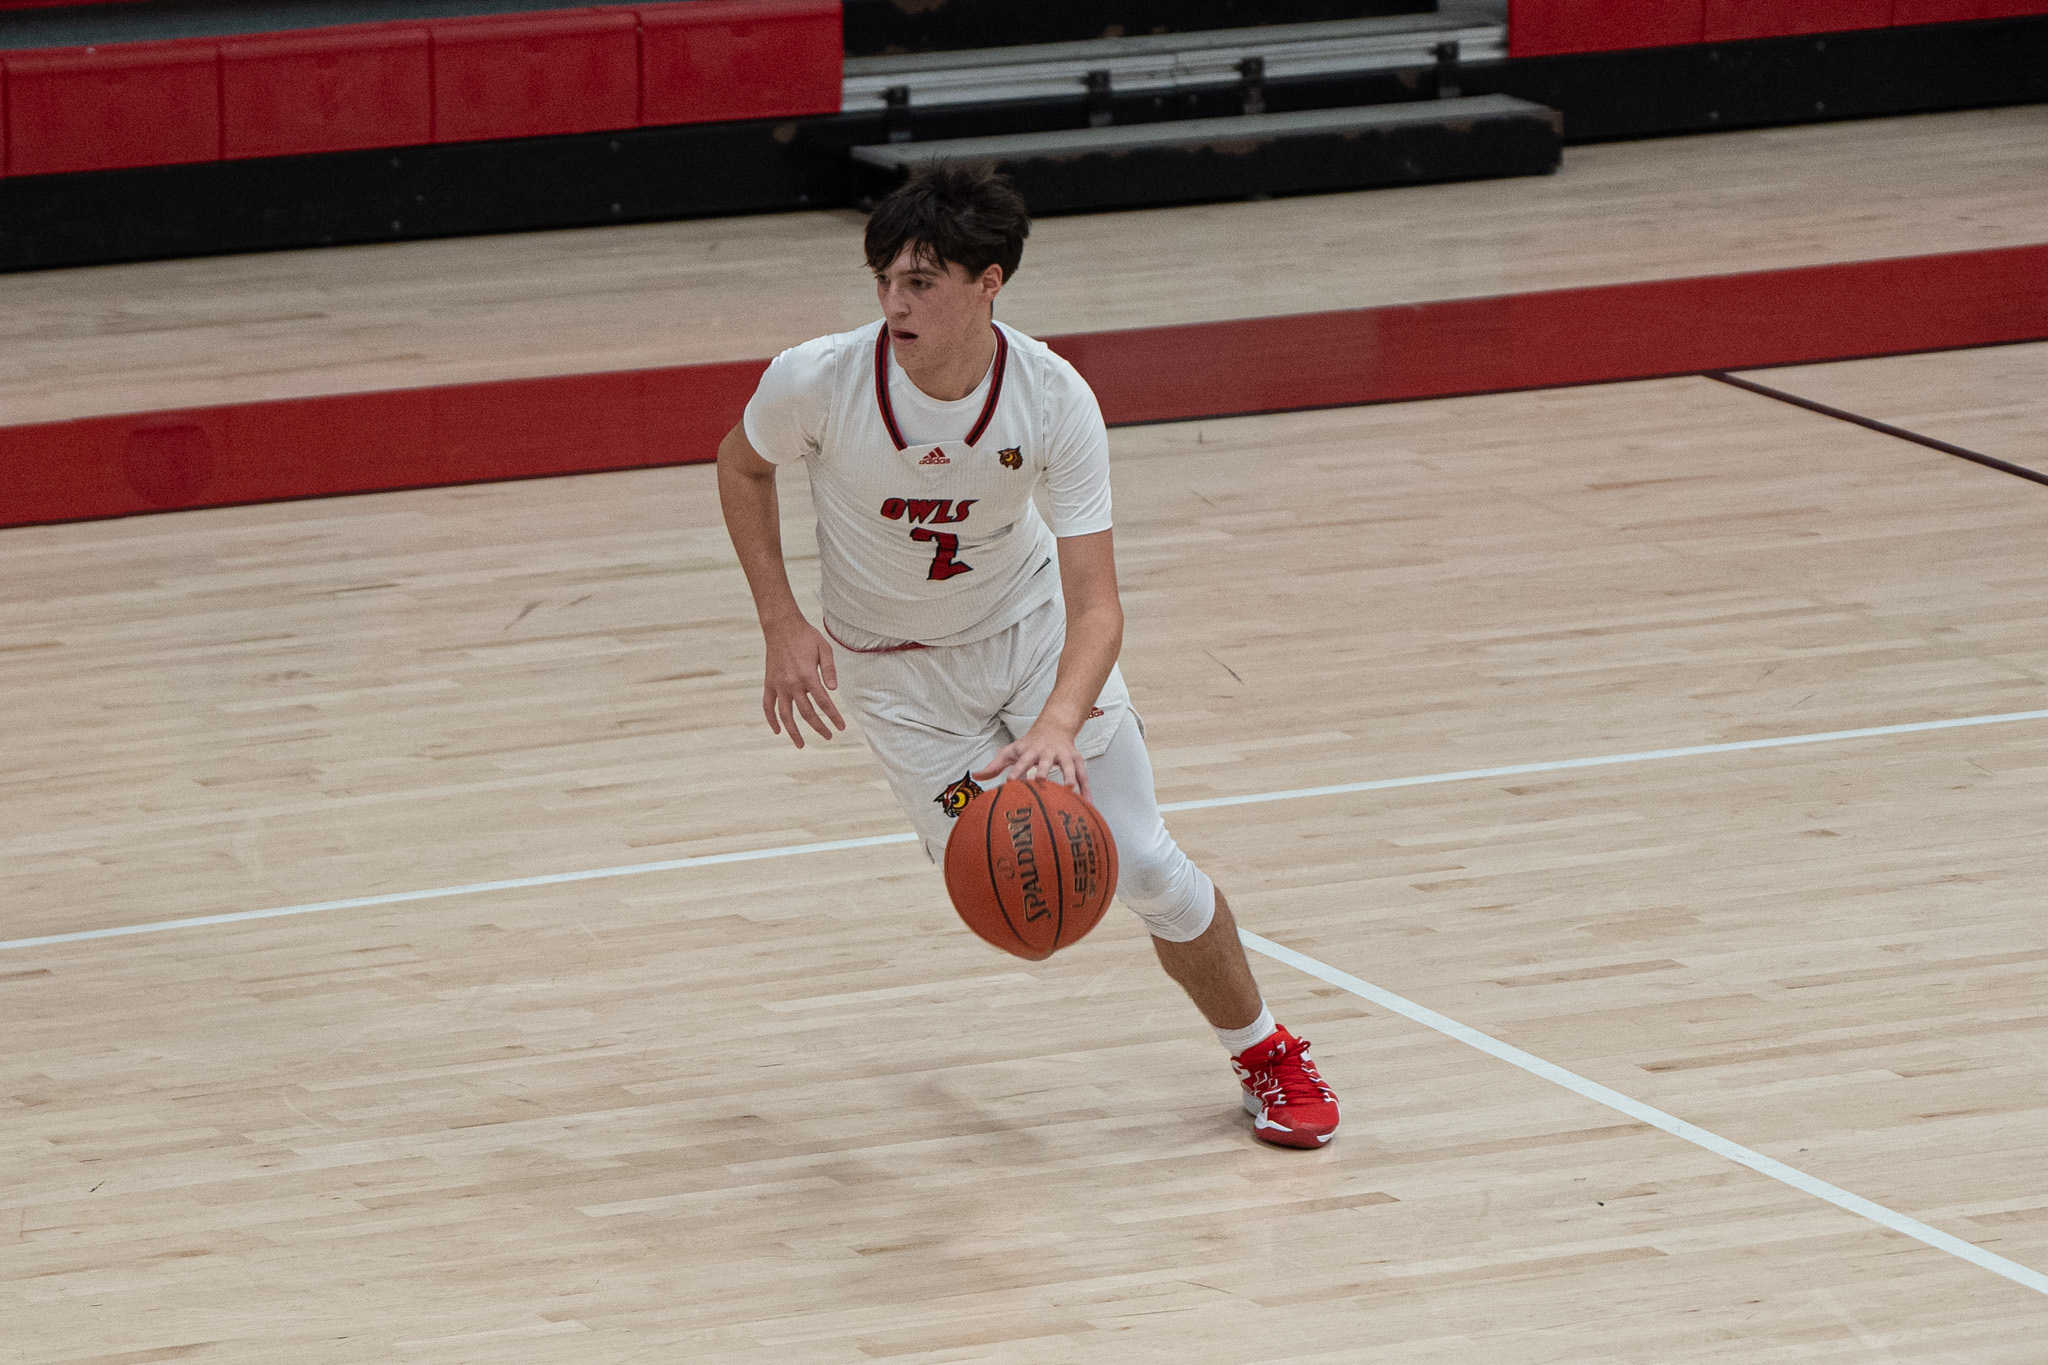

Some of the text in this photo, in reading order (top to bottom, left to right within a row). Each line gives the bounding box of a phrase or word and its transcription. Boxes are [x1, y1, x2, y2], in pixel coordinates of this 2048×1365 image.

[880, 497, 980, 524] OWLS
[909, 527, 974, 580] 2
[1006, 807, 1052, 922] SPALDING
